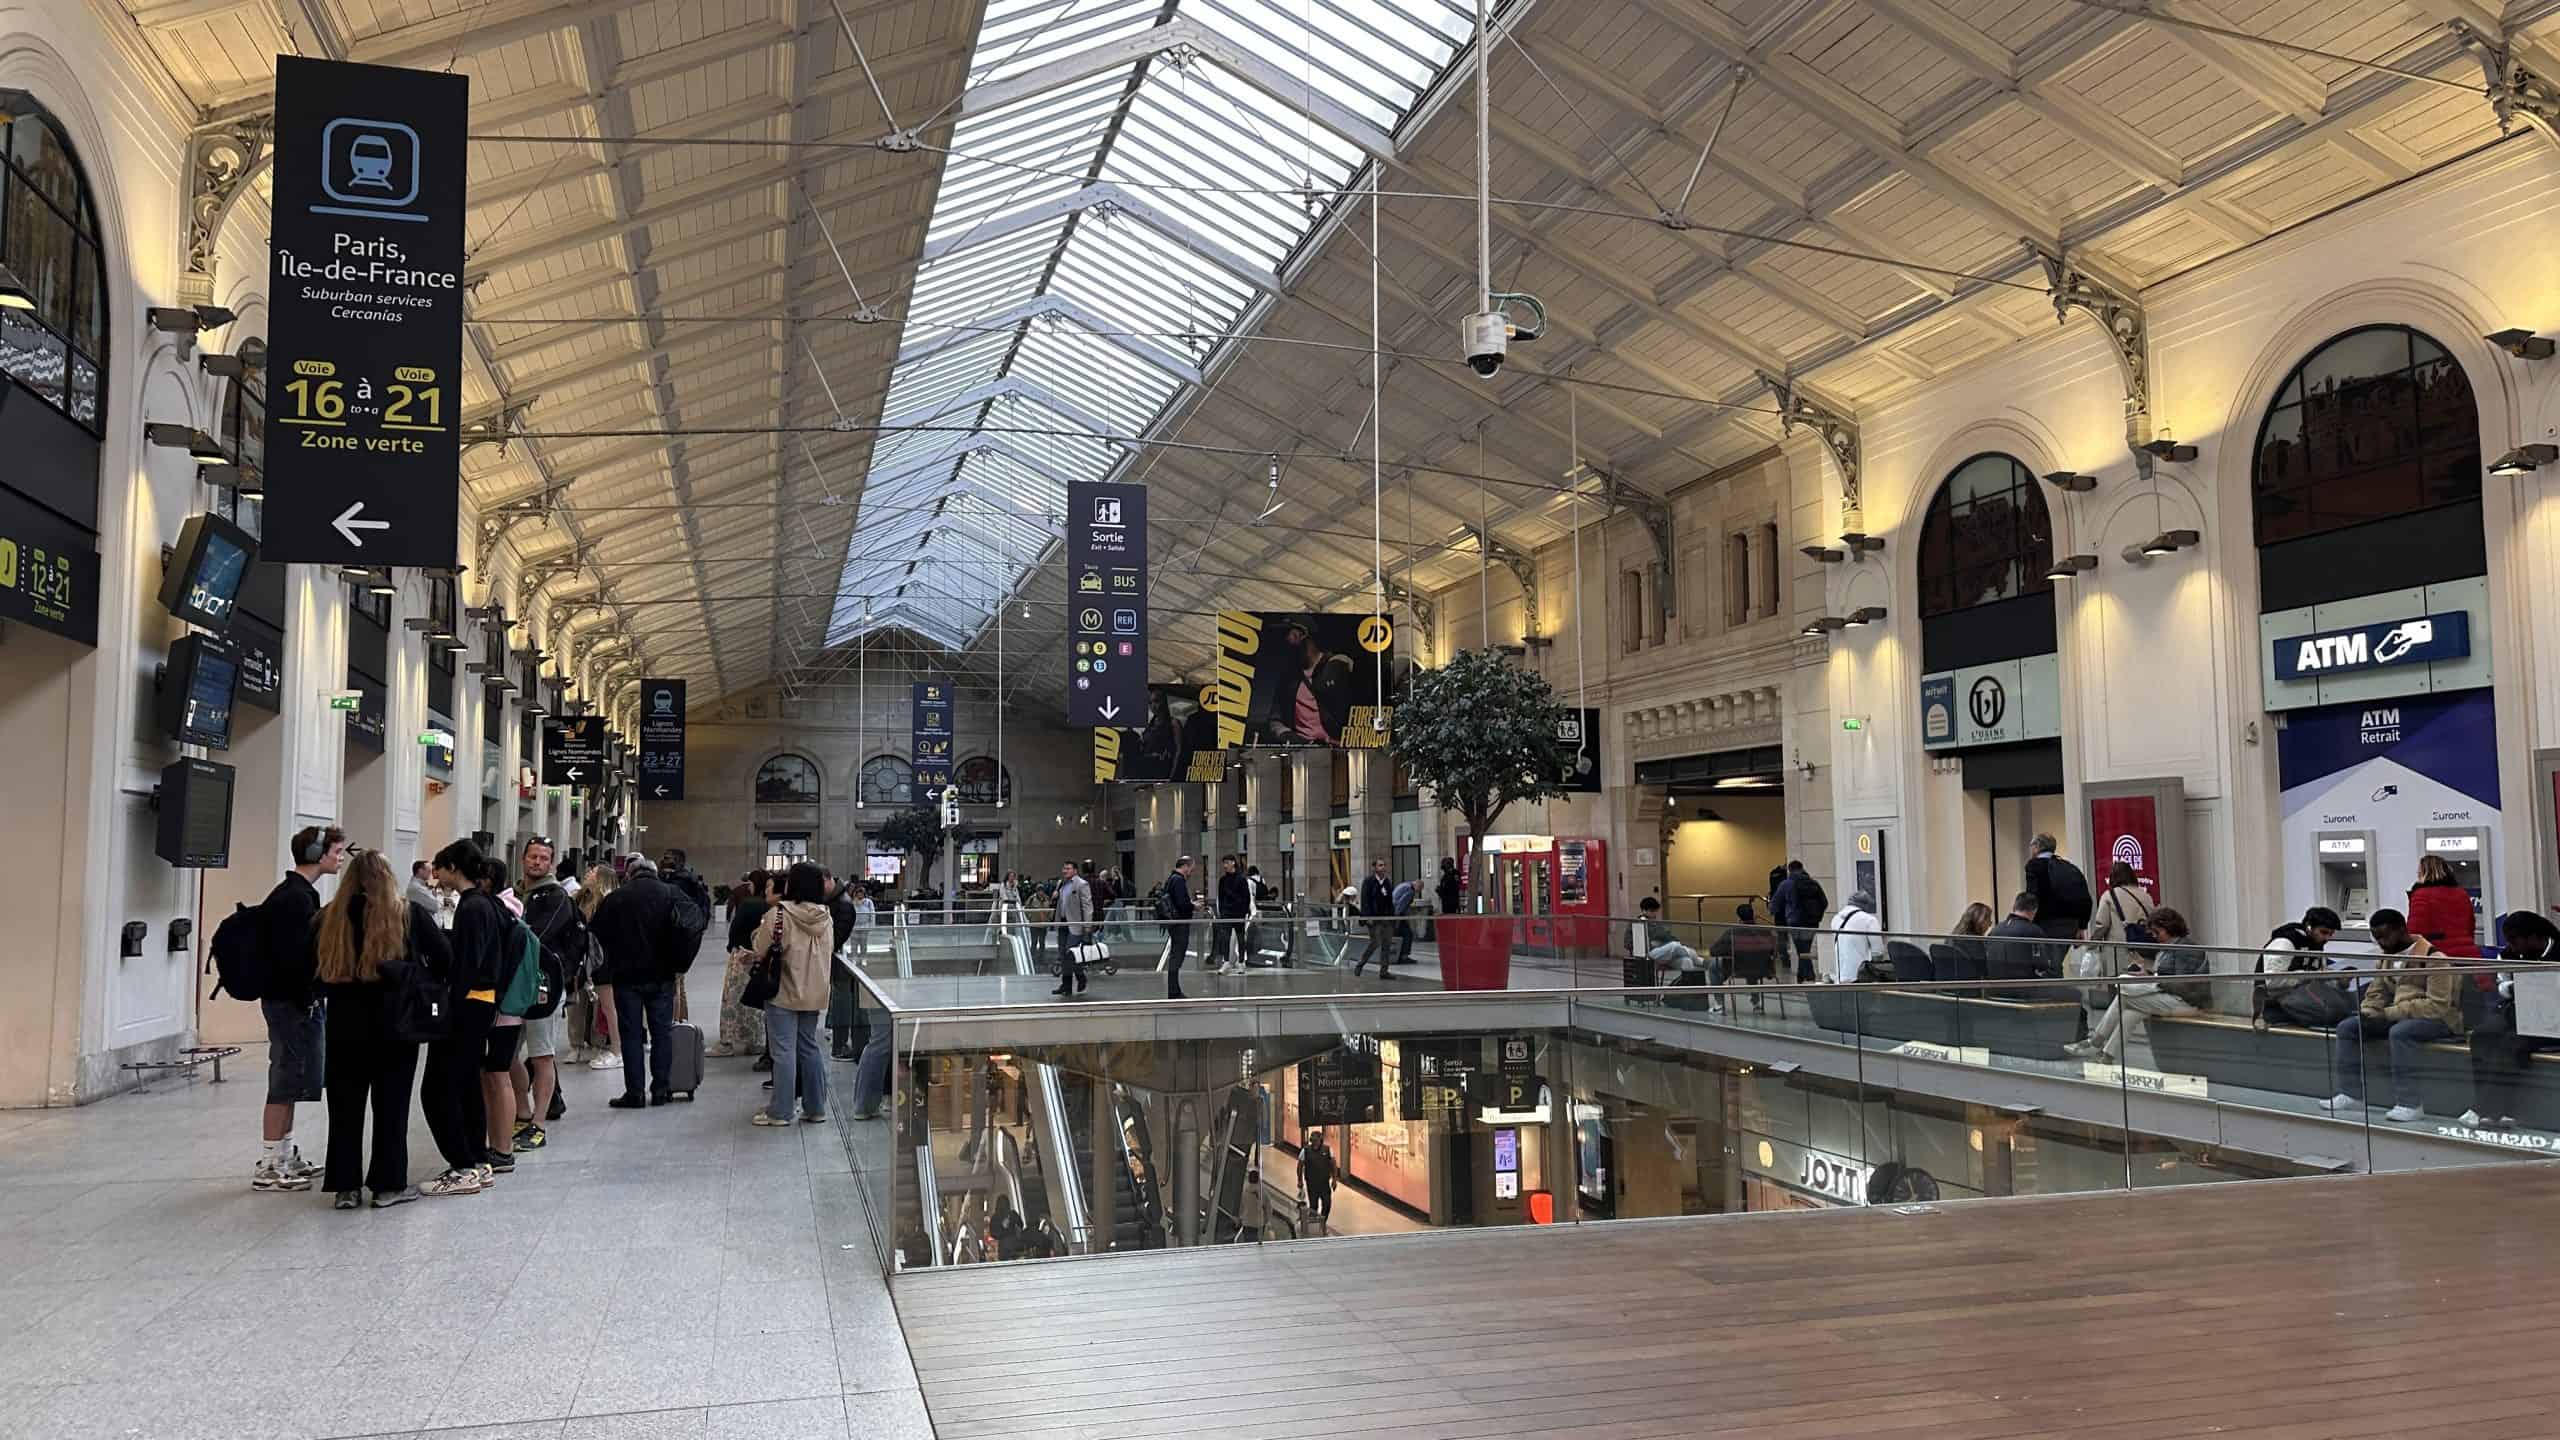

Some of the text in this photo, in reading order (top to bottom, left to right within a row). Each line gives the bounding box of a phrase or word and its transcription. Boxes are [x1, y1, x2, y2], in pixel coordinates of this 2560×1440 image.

[333, 232, 406, 263] Paris,
[278, 249, 456, 289] Île-de-France
[301, 286, 433, 308] Suburban services
[299, 362, 330, 375] Voie
[399, 368, 430, 381] Voie
[285, 377, 441, 425] 16 à 21
[301, 429, 424, 454] Zone verte
[1092, 531, 1124, 543] Sortie
[31, 562, 48, 594] 12
[55, 571, 71, 604] 21
[1113, 575, 1136, 588] BUS
[1117, 615, 1134, 625] RER
[2296, 632, 2368, 672] ATM
[2361, 707, 2400, 728] ATM
[2361, 729, 2401, 745] Retrait
[2331, 841, 2351, 849] ATM
[2440, 839, 2462, 848] ATM
[1510, 1086, 1522, 1105] P
[1377, 1143, 1399, 1169] LOVE
